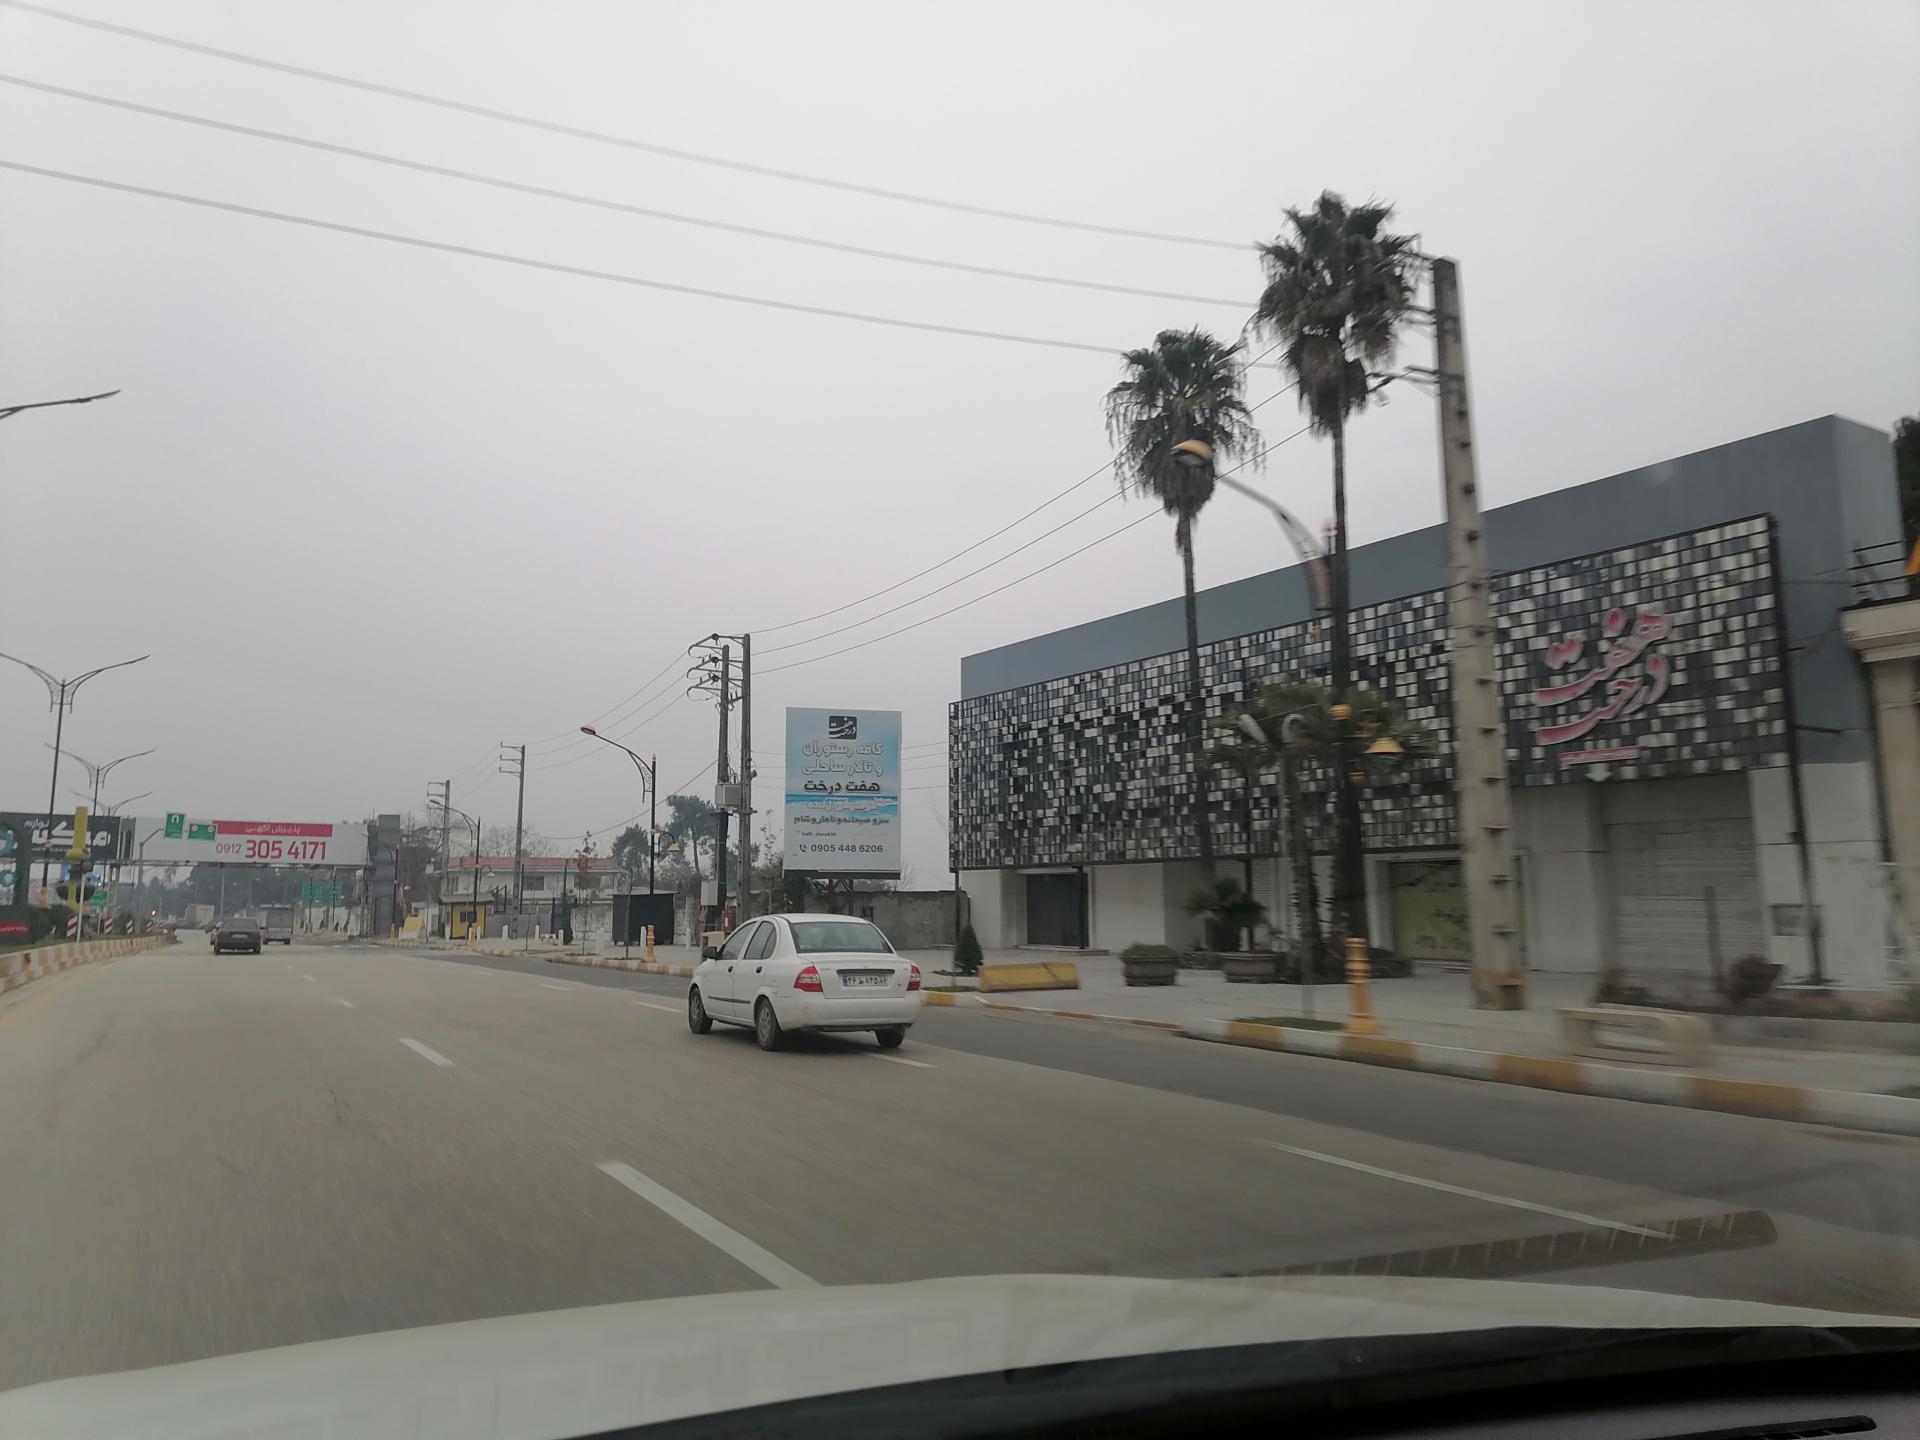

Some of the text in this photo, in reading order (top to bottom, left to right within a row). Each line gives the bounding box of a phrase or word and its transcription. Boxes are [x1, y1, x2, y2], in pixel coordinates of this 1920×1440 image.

[803, 740, 884, 758] کافه رستوران
[801, 758, 884, 777] و تالار ساحلی
[804, 779, 881, 794] هفت درخت
[216, 840, 327, 860] 0912 305 4171
[810, 844, 883, 853] 0905 448 6206
